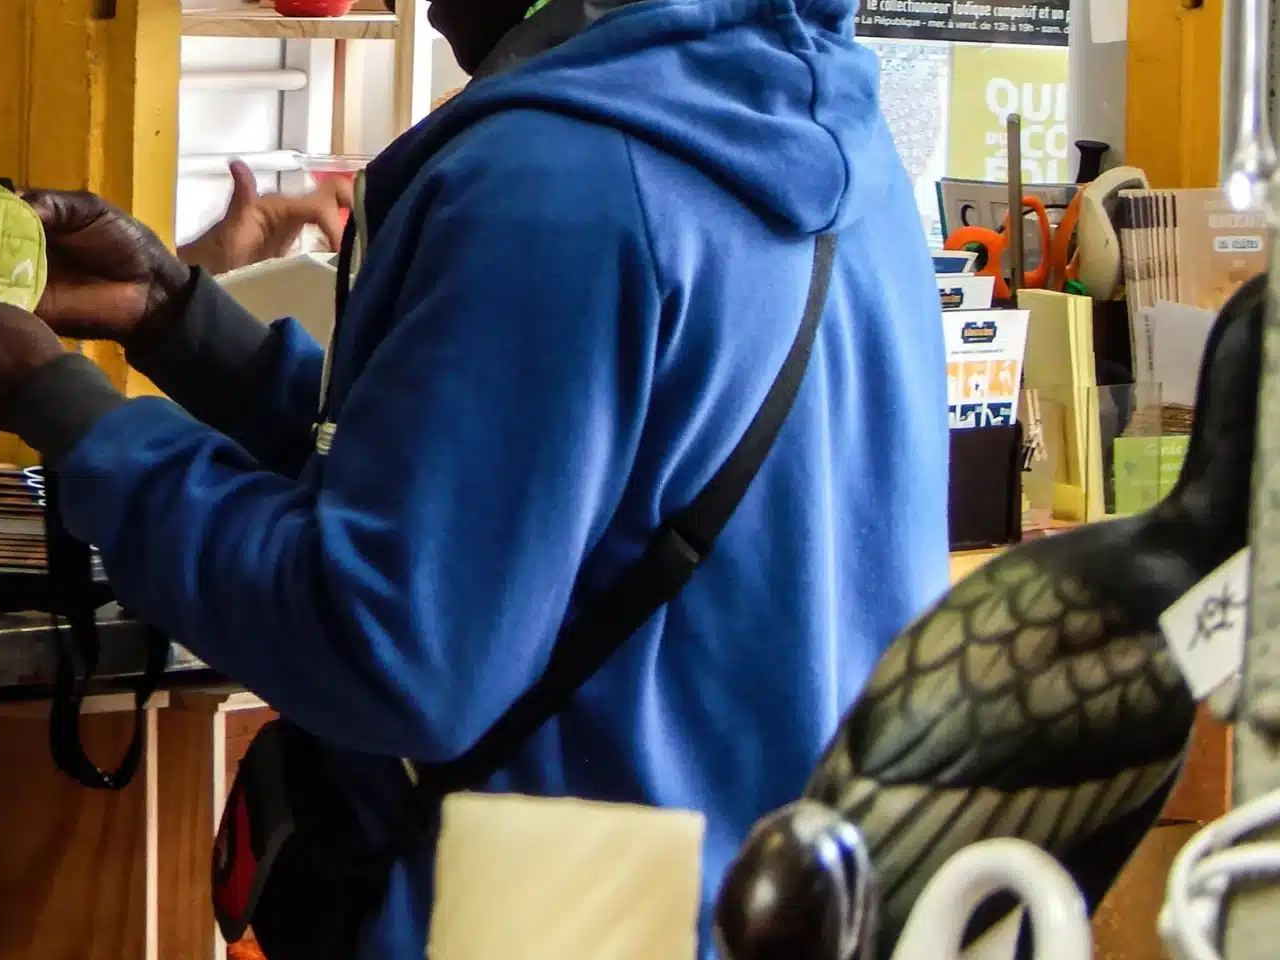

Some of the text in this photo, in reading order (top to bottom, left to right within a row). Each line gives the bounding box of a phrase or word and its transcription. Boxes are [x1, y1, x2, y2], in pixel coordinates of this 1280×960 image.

[1038, 6, 1050, 19] et
[861, 15, 873, 24] La
[873, 15, 921, 28] République
